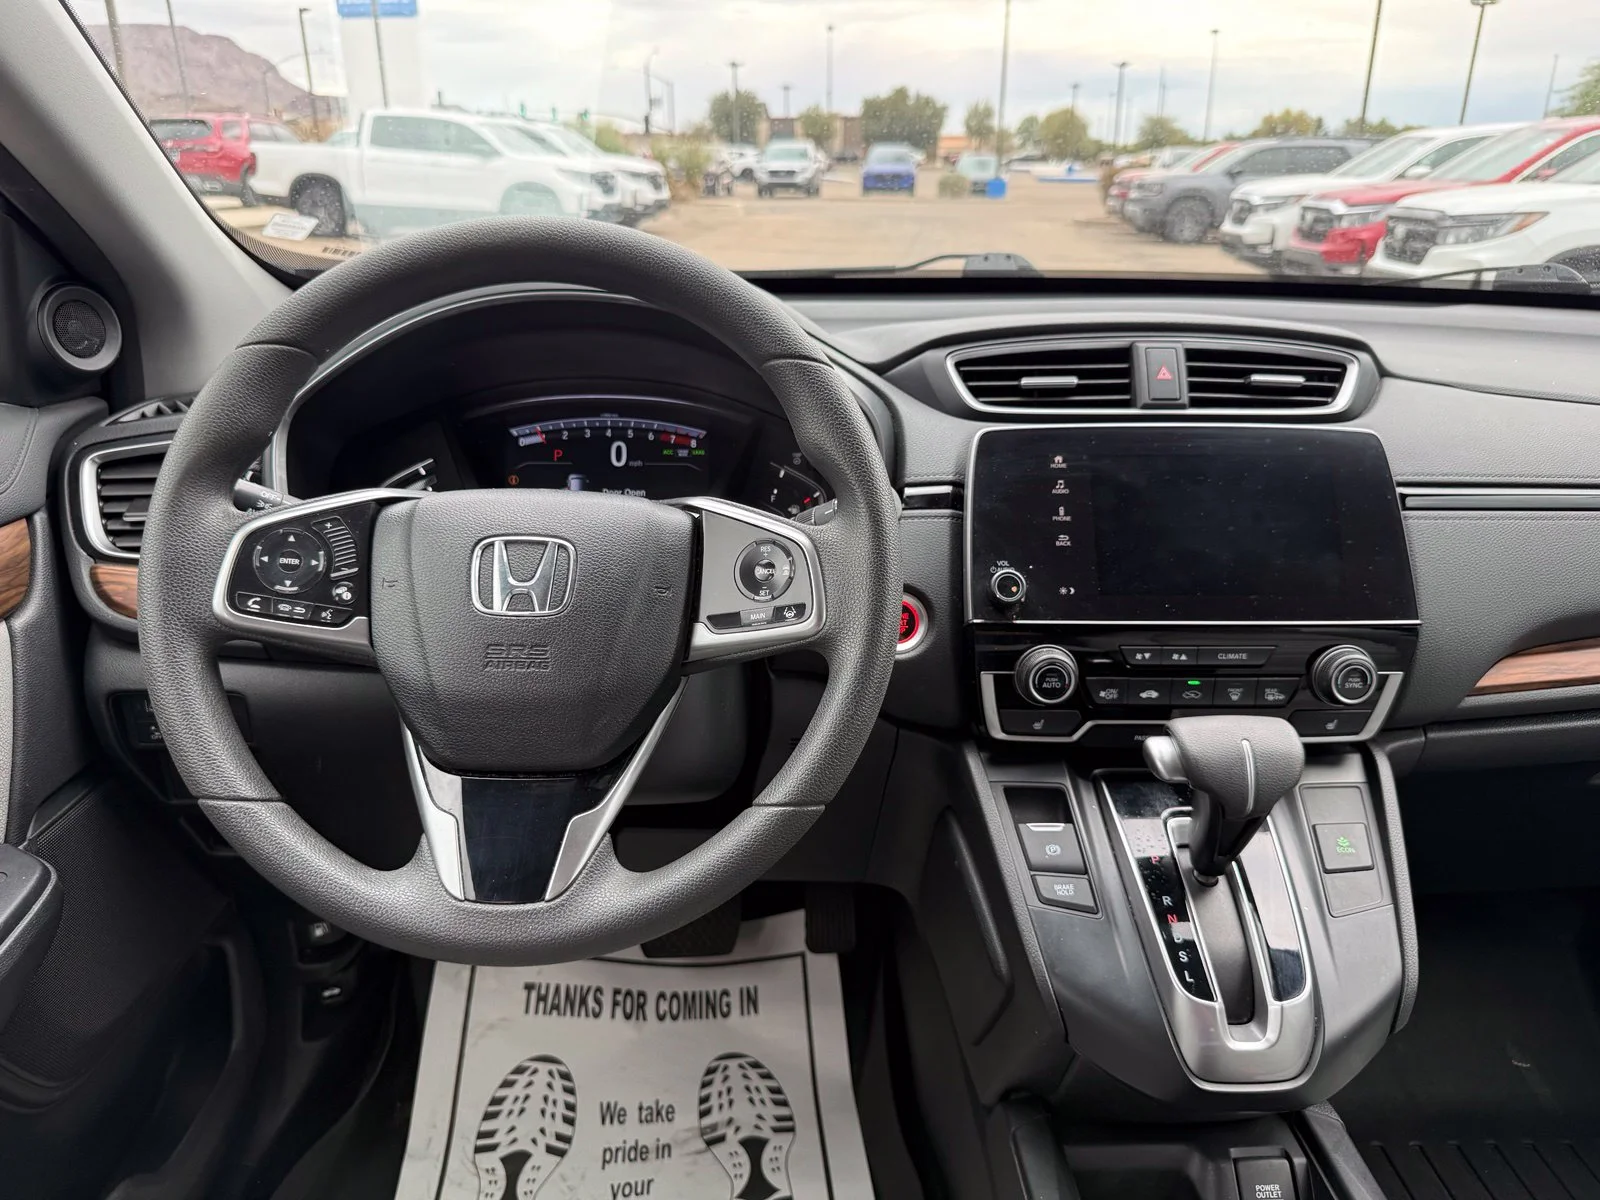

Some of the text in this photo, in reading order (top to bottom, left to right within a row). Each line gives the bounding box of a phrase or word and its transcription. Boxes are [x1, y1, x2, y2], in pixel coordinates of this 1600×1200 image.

[561, 430, 569, 440] 2
[584, 428, 591, 438] 3
[606, 428, 612, 438] 4
[627, 428, 634, 438] 5
[648, 432, 655, 441] 6
[670, 434, 676, 444] 7
[690, 439, 697, 448] 8
[553, 449, 563, 461] P
[610, 440, 628, 468] 0
[1150, 856, 1160, 864] P
[1162, 896, 1173, 906] R
[1167, 914, 1178, 924] N
[1178, 951, 1188, 962] S
[1184, 970, 1194, 982] L
[524, 982, 760, 1022] THANKS FOR COMING IN
[599, 1098, 676, 1126] We take
[602, 1138, 672, 1170] pride in
[610, 1177, 654, 1200] your
